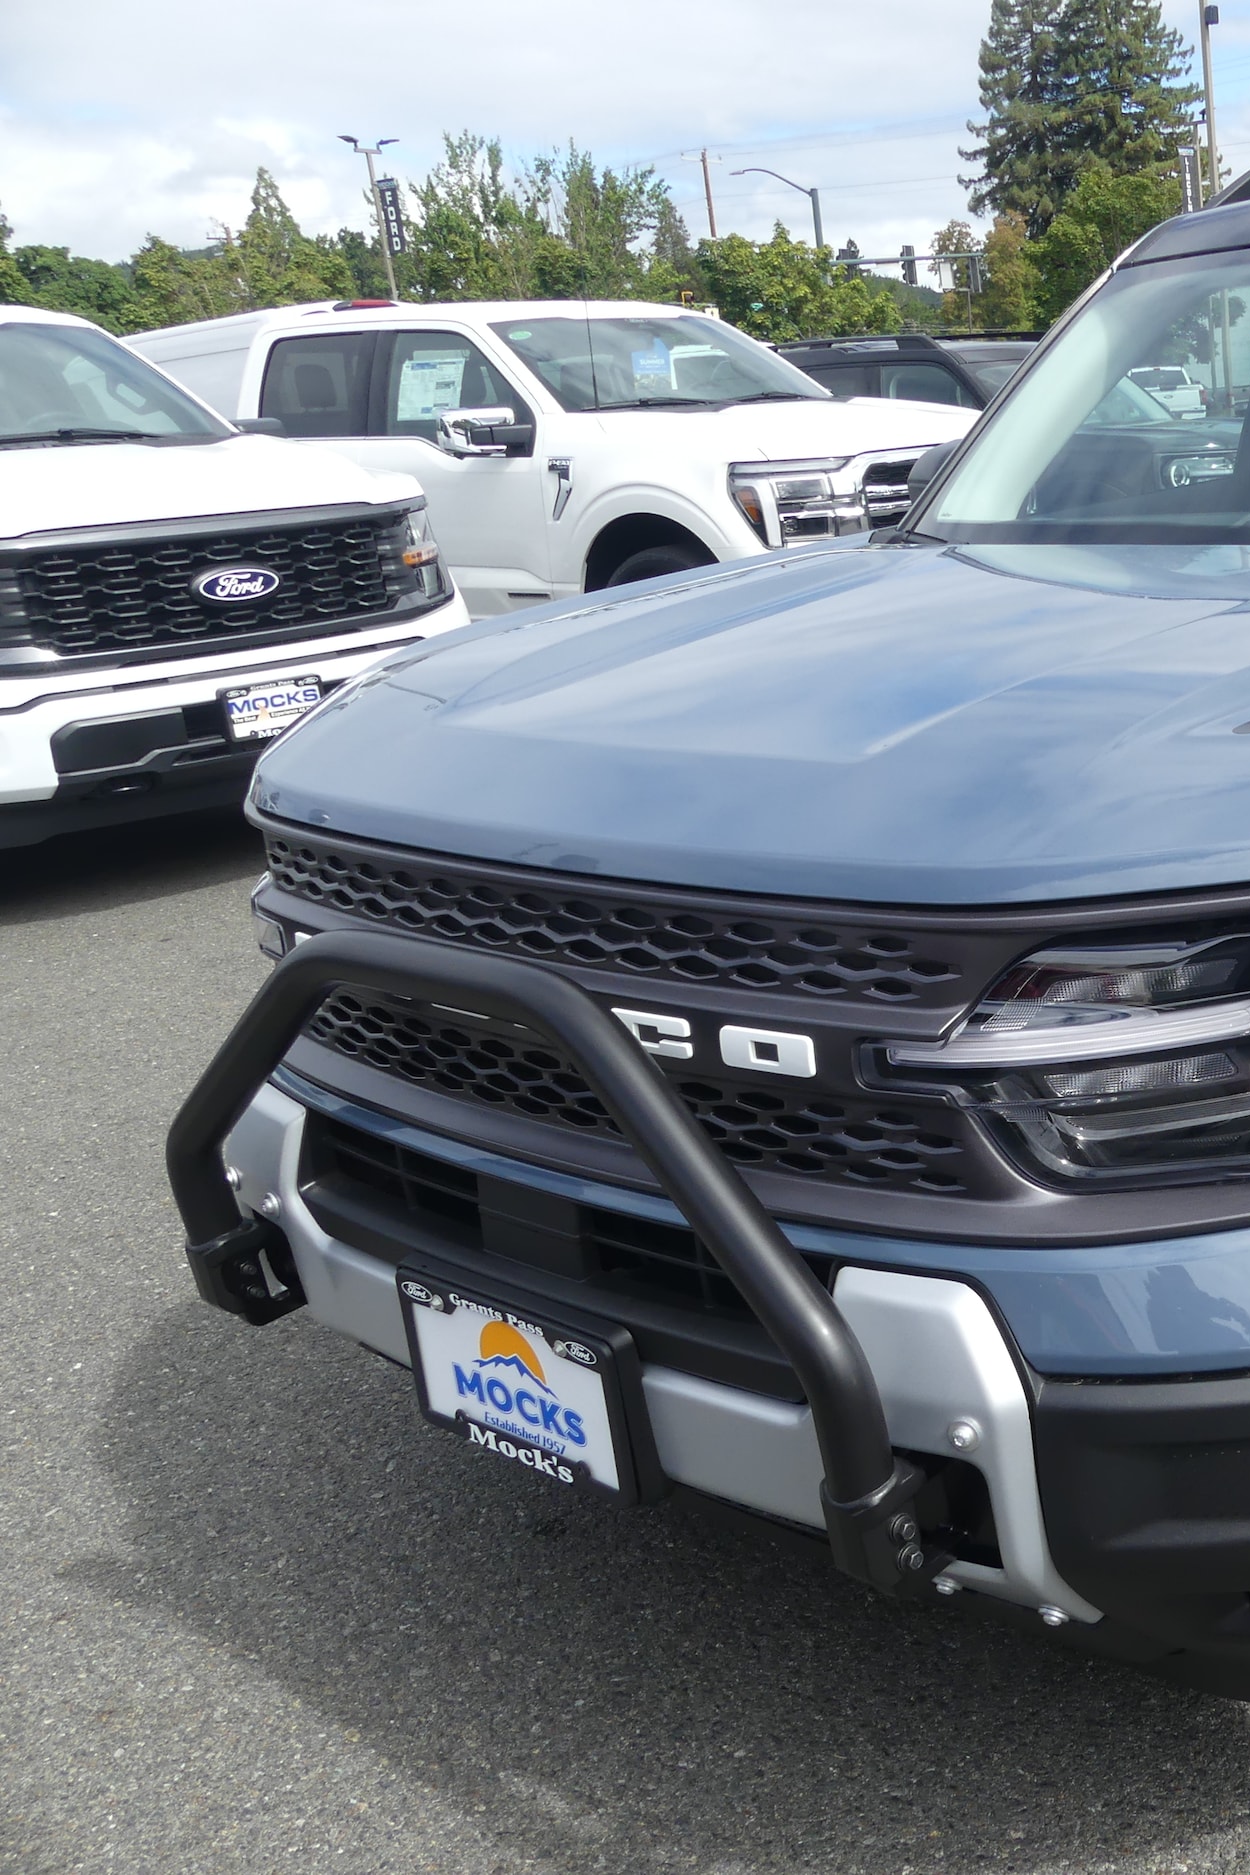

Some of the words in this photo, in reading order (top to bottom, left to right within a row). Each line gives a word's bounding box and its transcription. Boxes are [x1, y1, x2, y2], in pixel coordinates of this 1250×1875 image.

[385, 191, 401, 251] FORD
[215, 573, 264, 597] Ford
[228, 689, 318, 715] MOCKS
[449, 1293, 503, 1321] Grants
[505, 1313, 544, 1337] Pass
[452, 1362, 587, 1447] MOCKS
[467, 1422, 575, 1484] Mock's
[484, 1411, 541, 1444] Established
[541, 1436, 567, 1455] 1957
